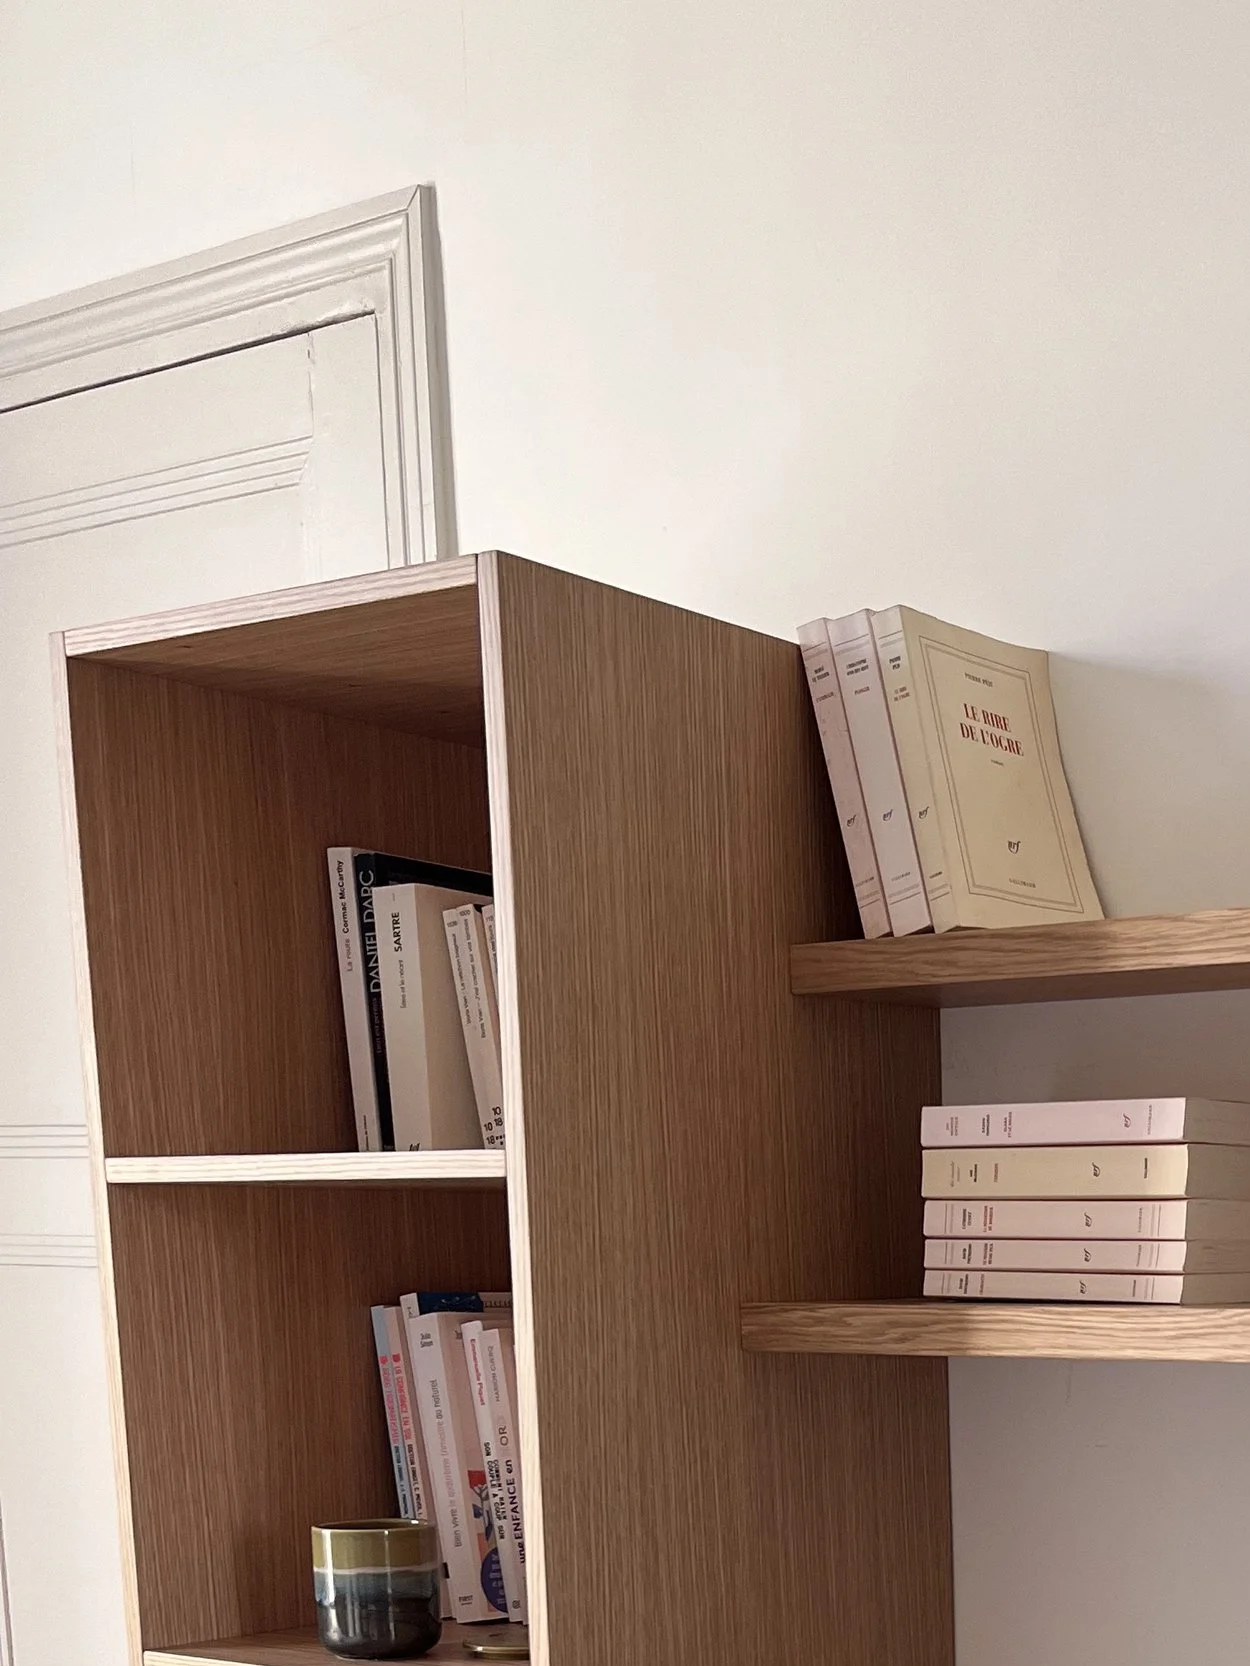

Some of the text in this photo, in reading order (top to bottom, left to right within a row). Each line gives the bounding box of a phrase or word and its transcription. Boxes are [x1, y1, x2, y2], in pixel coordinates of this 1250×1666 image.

[963, 703, 1011, 733] LE RIRE
[960, 722, 1024, 757] DE L'OGRE
[336, 860, 346, 900] McCarthy
[340, 902, 350, 934] Cormac
[391, 911, 403, 952] SARTRE
[484, 1122, 493, 1132] 10
[486, 1135, 496, 1145] 18
[429, 1379, 440, 1408] naturel
[436, 1409, 444, 1420] au
[487, 1460, 497, 1488] COUPLE
[494, 1501, 502, 1521] COUP
[498, 1425, 526, 1564] une ENFANCE en OR
